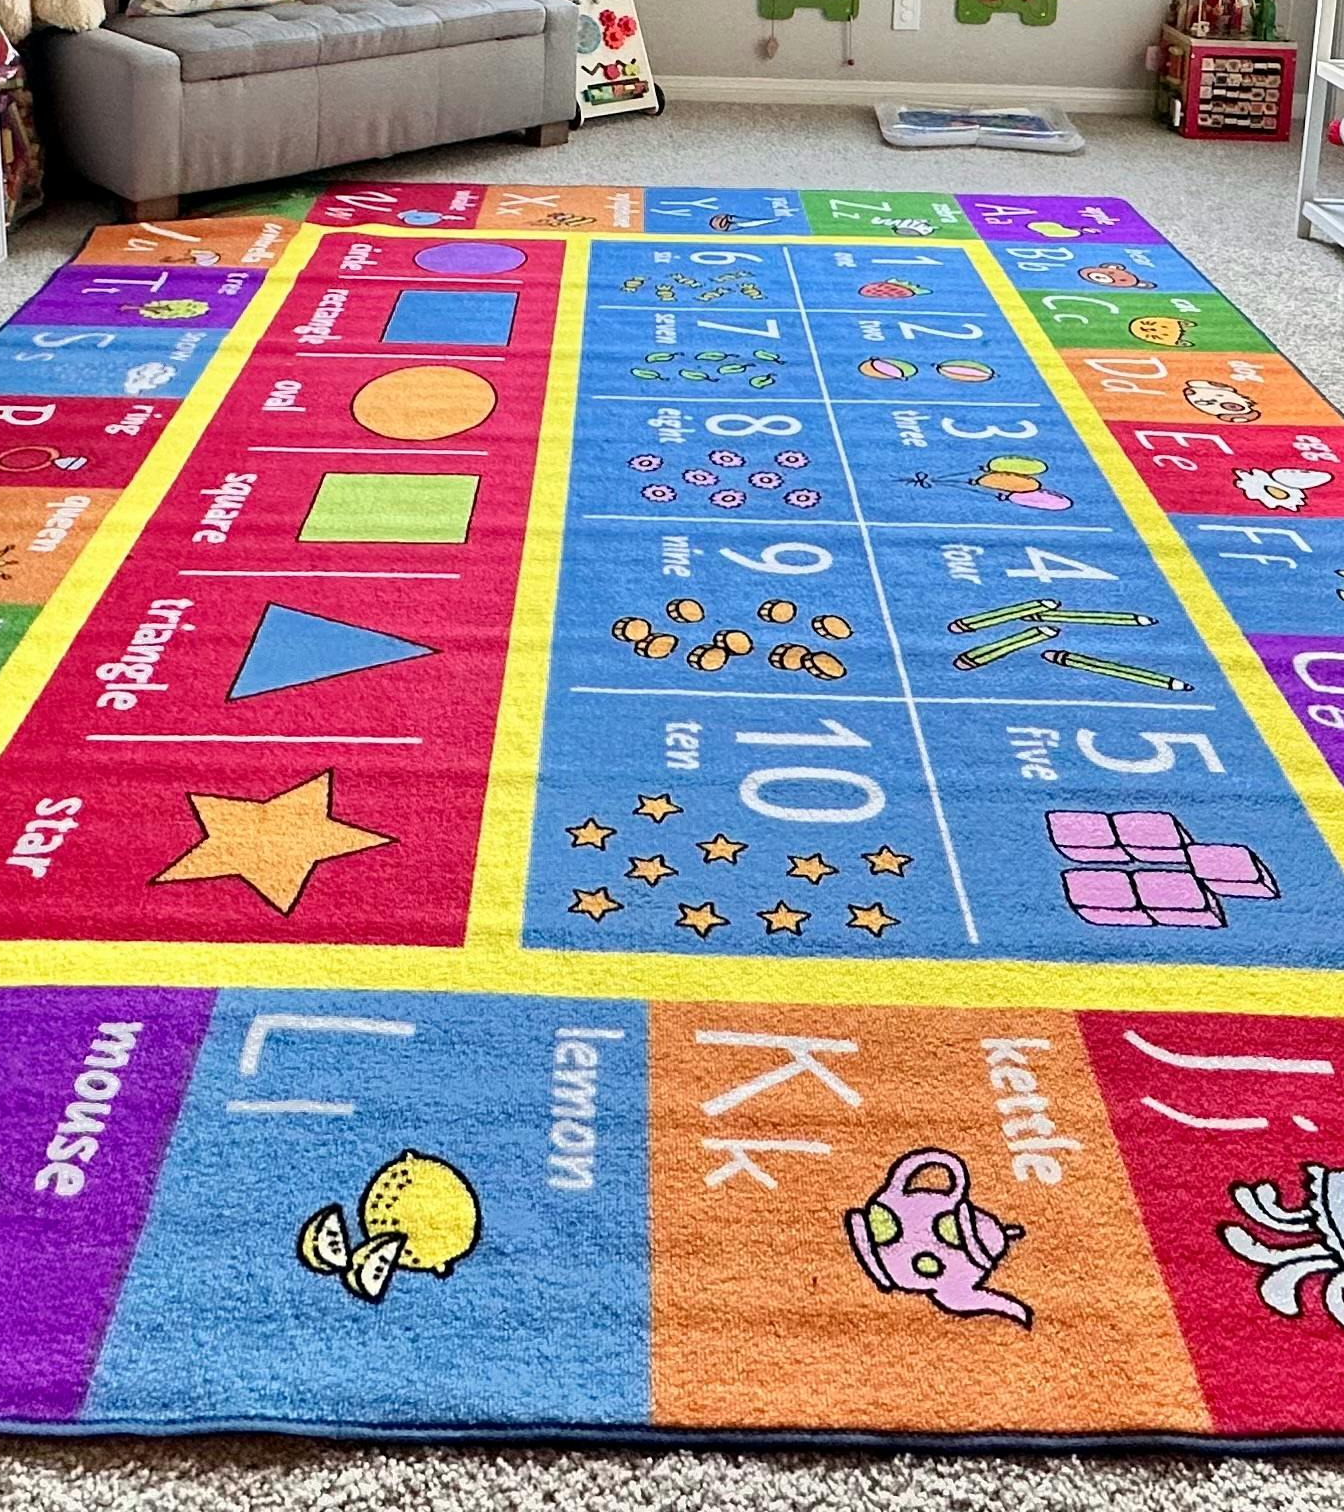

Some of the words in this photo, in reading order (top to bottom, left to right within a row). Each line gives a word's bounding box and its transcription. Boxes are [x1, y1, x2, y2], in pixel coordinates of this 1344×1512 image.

[828, 198, 893, 221] Zz
[975, 202, 1038, 226] Aa
[689, 250, 764, 266] 6
[870, 255, 946, 267] 1
[1005, 246, 1074, 273] Bb
[653, 312, 678, 345] seven
[696, 318, 782, 339] 7
[1041, 294, 1121, 326] Cc
[14, 331, 116, 363] Ss
[169, 331, 207, 362] snow
[858, 320, 886, 342] two
[896, 320, 985, 341] 2
[1082, 356, 1170, 397] Dd
[1227, 359, 1266, 384] dog
[260, 379, 307, 413] oval
[104, 404, 164, 438] ring
[647, 407, 699, 445] eight
[704, 412, 804, 439] 8
[890, 409, 932, 448] three
[941, 415, 1040, 440] 3
[1133, 429, 1235, 472] Ee
[1291, 433, 1342, 464] egg
[27, 494, 93, 554] queen
[190, 472, 258, 545] square
[660, 534, 706, 579] nine
[718, 541, 834, 576] 9
[940, 543, 986, 586] four
[1005, 545, 1121, 584] 4
[1196, 522, 1313, 570] Ff
[95, 597, 197, 712] triangle
[663, 718, 705, 771] ten
[1005, 725, 1061, 782] five
[1075, 727, 1228, 774] 5
[734, 717, 887, 824] 10
[5, 795, 84, 880] star
[1122, 1028, 1335, 1133] Jj
[33, 1020, 145, 1198] mouse
[545, 1026, 626, 1190] lemon
[695, 1029, 864, 1191] Kk
[981, 1037, 1083, 1186] kettle
